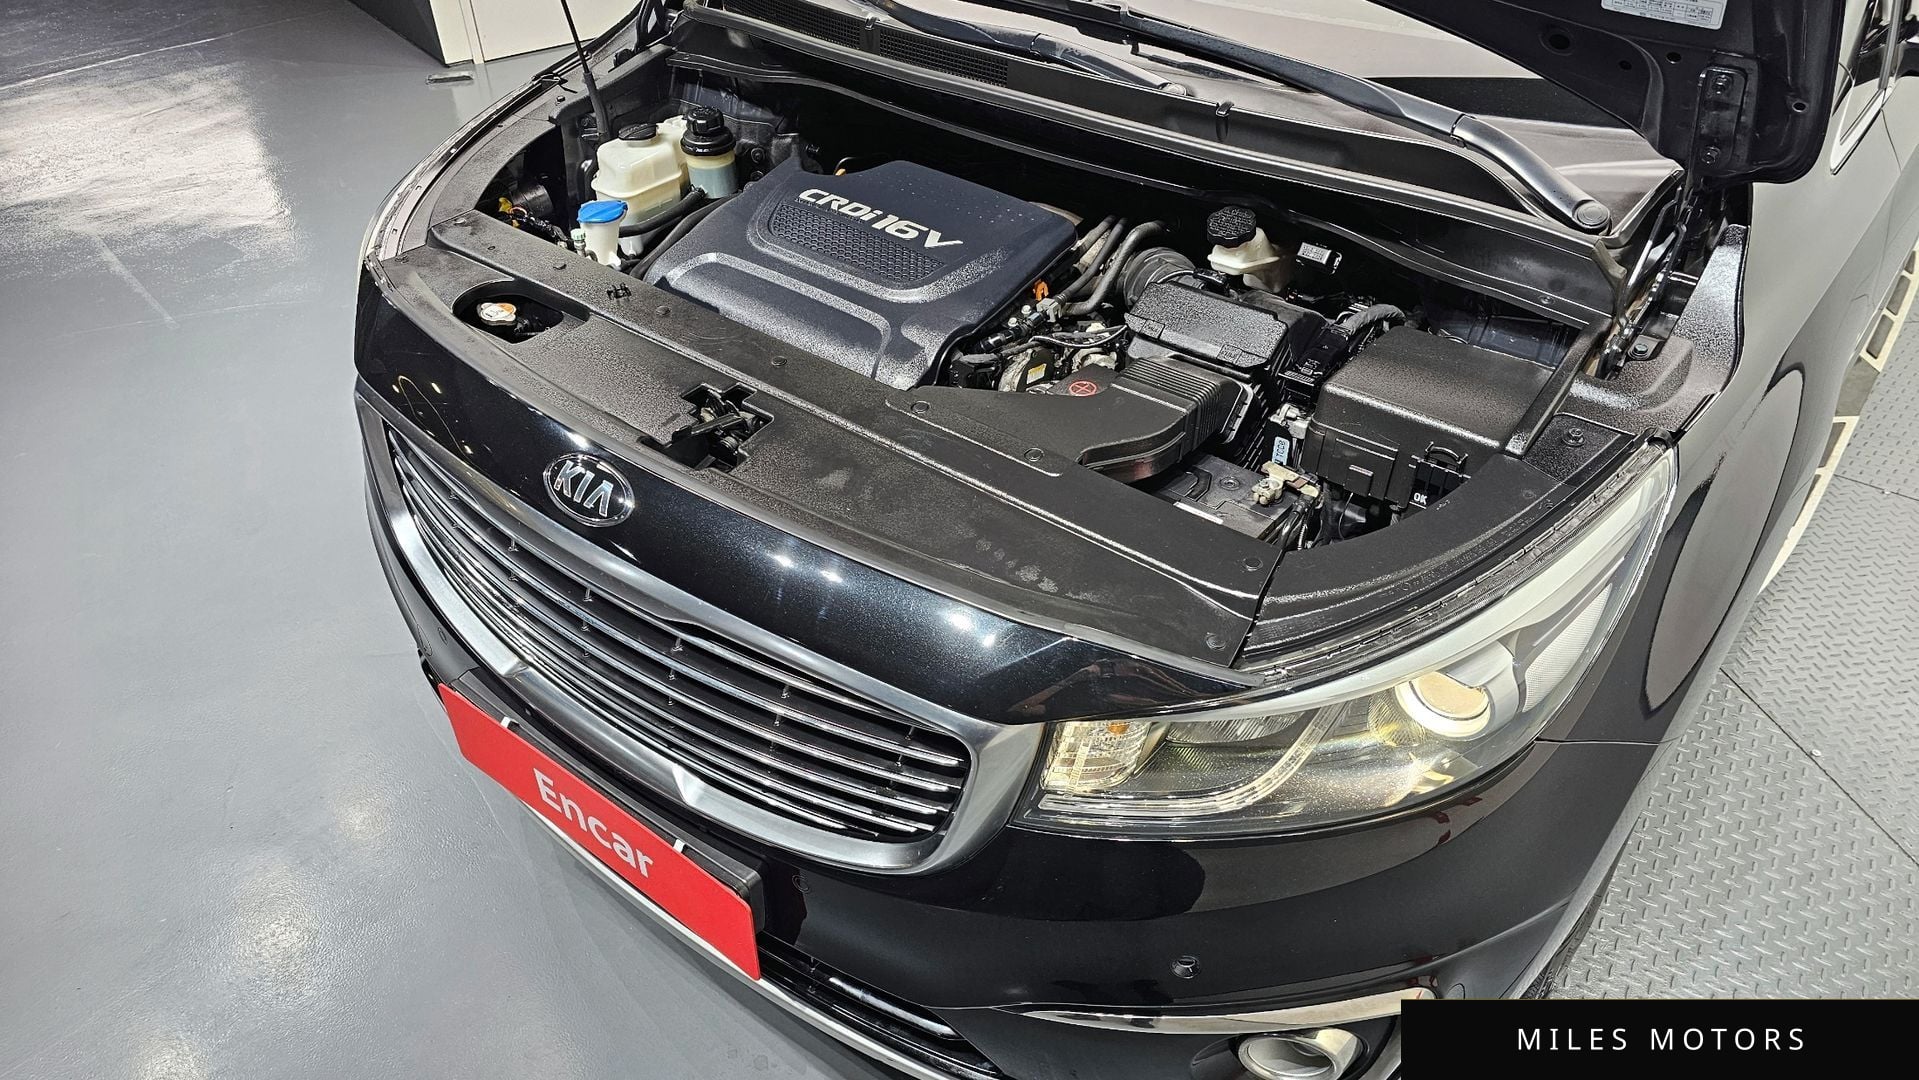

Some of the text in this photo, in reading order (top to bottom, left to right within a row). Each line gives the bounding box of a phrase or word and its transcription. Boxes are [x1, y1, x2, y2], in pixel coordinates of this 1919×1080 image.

[553, 459, 614, 518] KIA
[1413, 492, 1428, 505] OK
[533, 767, 654, 879] Encar
